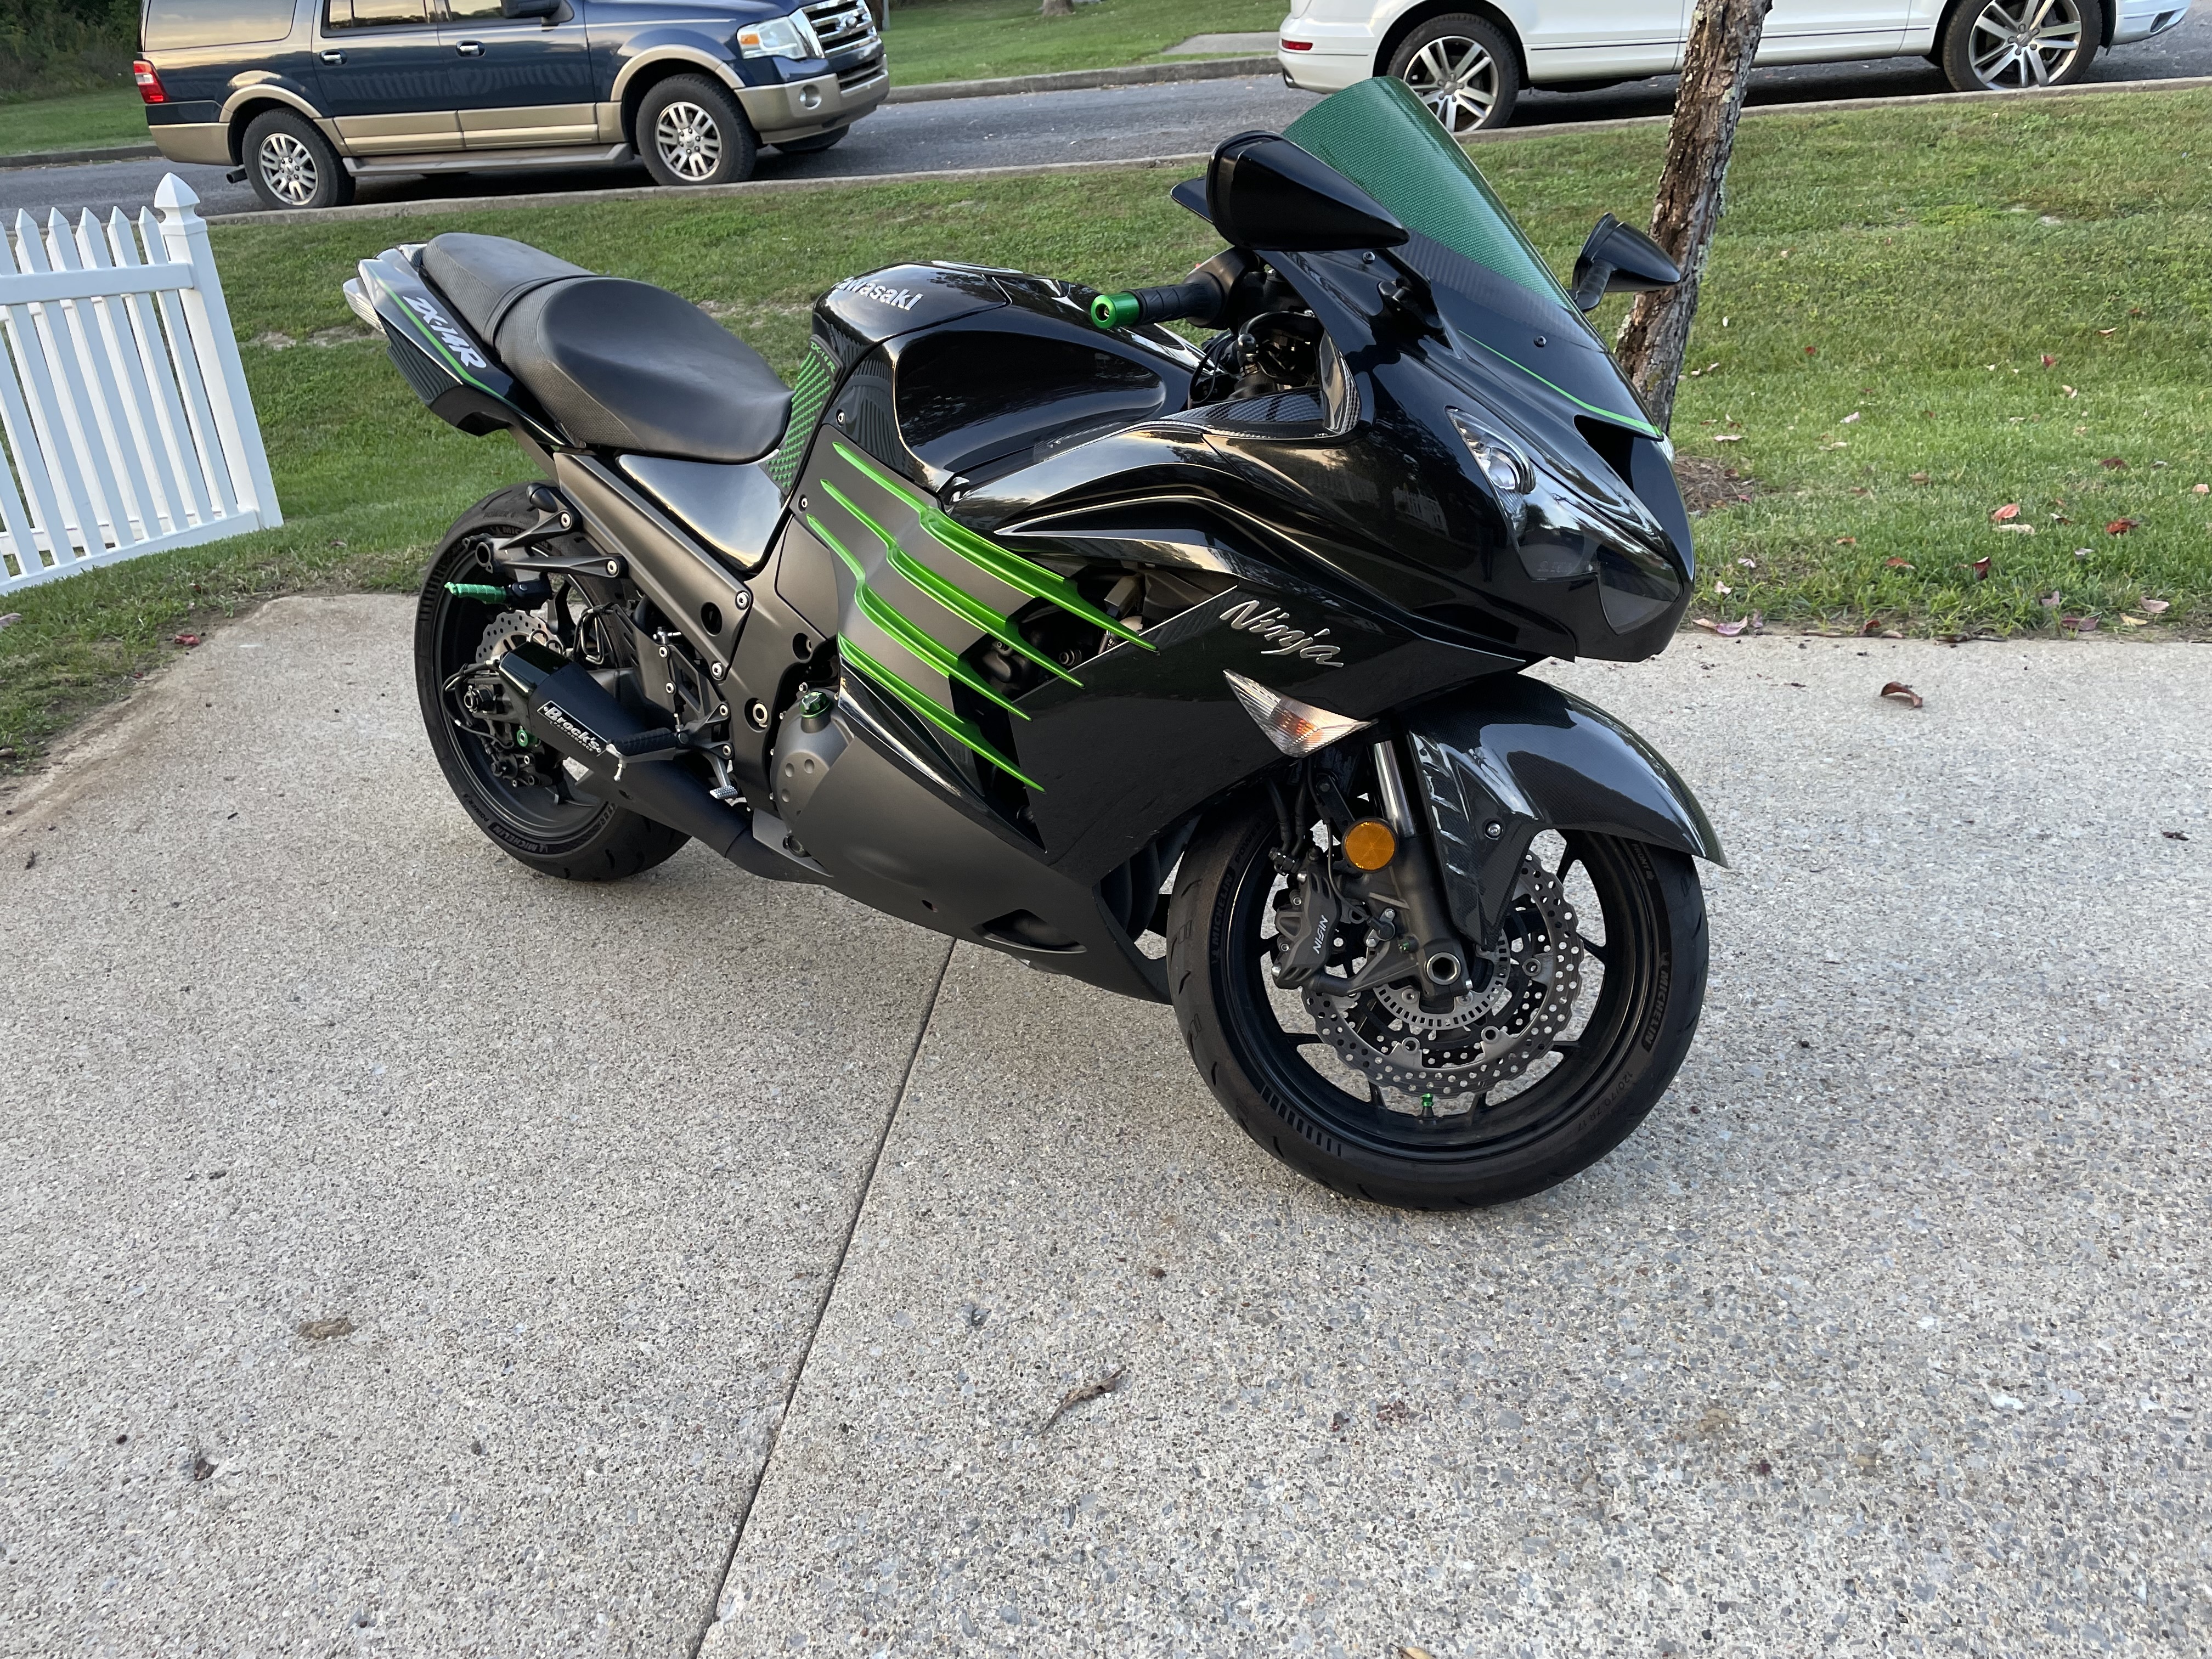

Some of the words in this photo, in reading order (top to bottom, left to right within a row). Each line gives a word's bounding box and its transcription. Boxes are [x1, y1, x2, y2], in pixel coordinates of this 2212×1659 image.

[1220, 600, 1344, 668] Ninja
[545, 707, 600, 750] Brock's
[493, 826, 539, 853] MICHELIN
[1632, 843, 1651, 871] FRONT
[1211, 874, 1233, 946] MICHELIN
[1313, 915, 1329, 955] NISSIN
[1644, 969, 1669, 1046] MICHELIN
[1605, 1072, 1633, 1107] 120/70
[1577, 1120, 1588, 1132] 17
